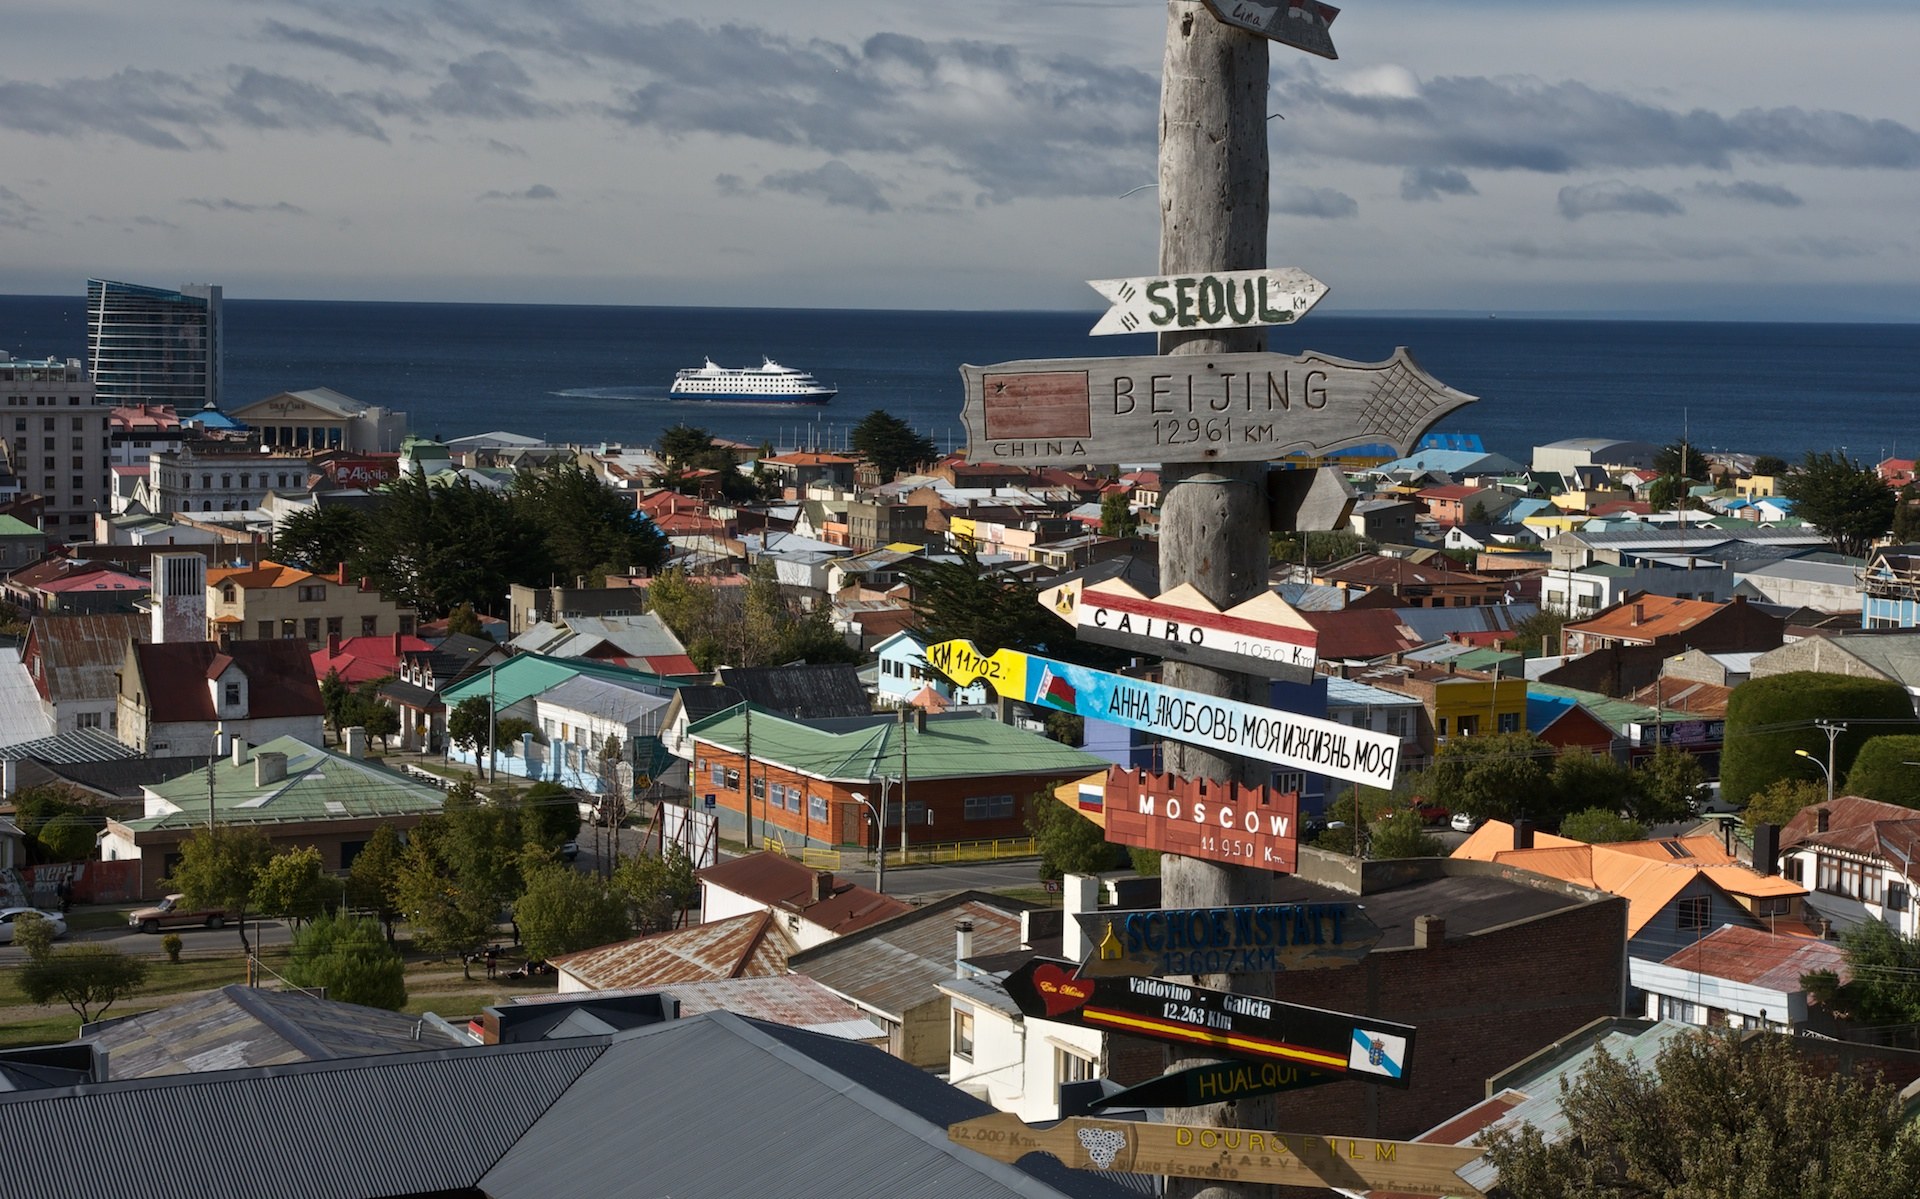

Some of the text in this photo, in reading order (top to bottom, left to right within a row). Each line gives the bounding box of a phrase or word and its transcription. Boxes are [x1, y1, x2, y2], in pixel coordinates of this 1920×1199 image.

[1232, 4, 1261, 27] Lima
[1146, 275, 1294, 326] SEOUL
[1113, 370, 1328, 416] BEIJING
[1153, 417, 1279, 446] 12.961 KM.
[993, 441, 1088, 458] CHINA
[1094, 608, 1205, 645] CAIRO
[1234, 640, 1286, 662] 11050
[1354, 742, 1395, 781] МОЯ
[1139, 794, 1289, 838] MOSCOW
[1201, 836, 1285, 864] 11.950 Km
[1125, 905, 1348, 951] SCHOENSTATT
[1129, 976, 1191, 1002] Valdovino
[1223, 994, 1272, 1020] Galicia
[1162, 1002, 1205, 1025] 12.263
[952, 1126, 1006, 1142] 12.000
[1176, 1127, 1396, 1161] DOURO FILM
